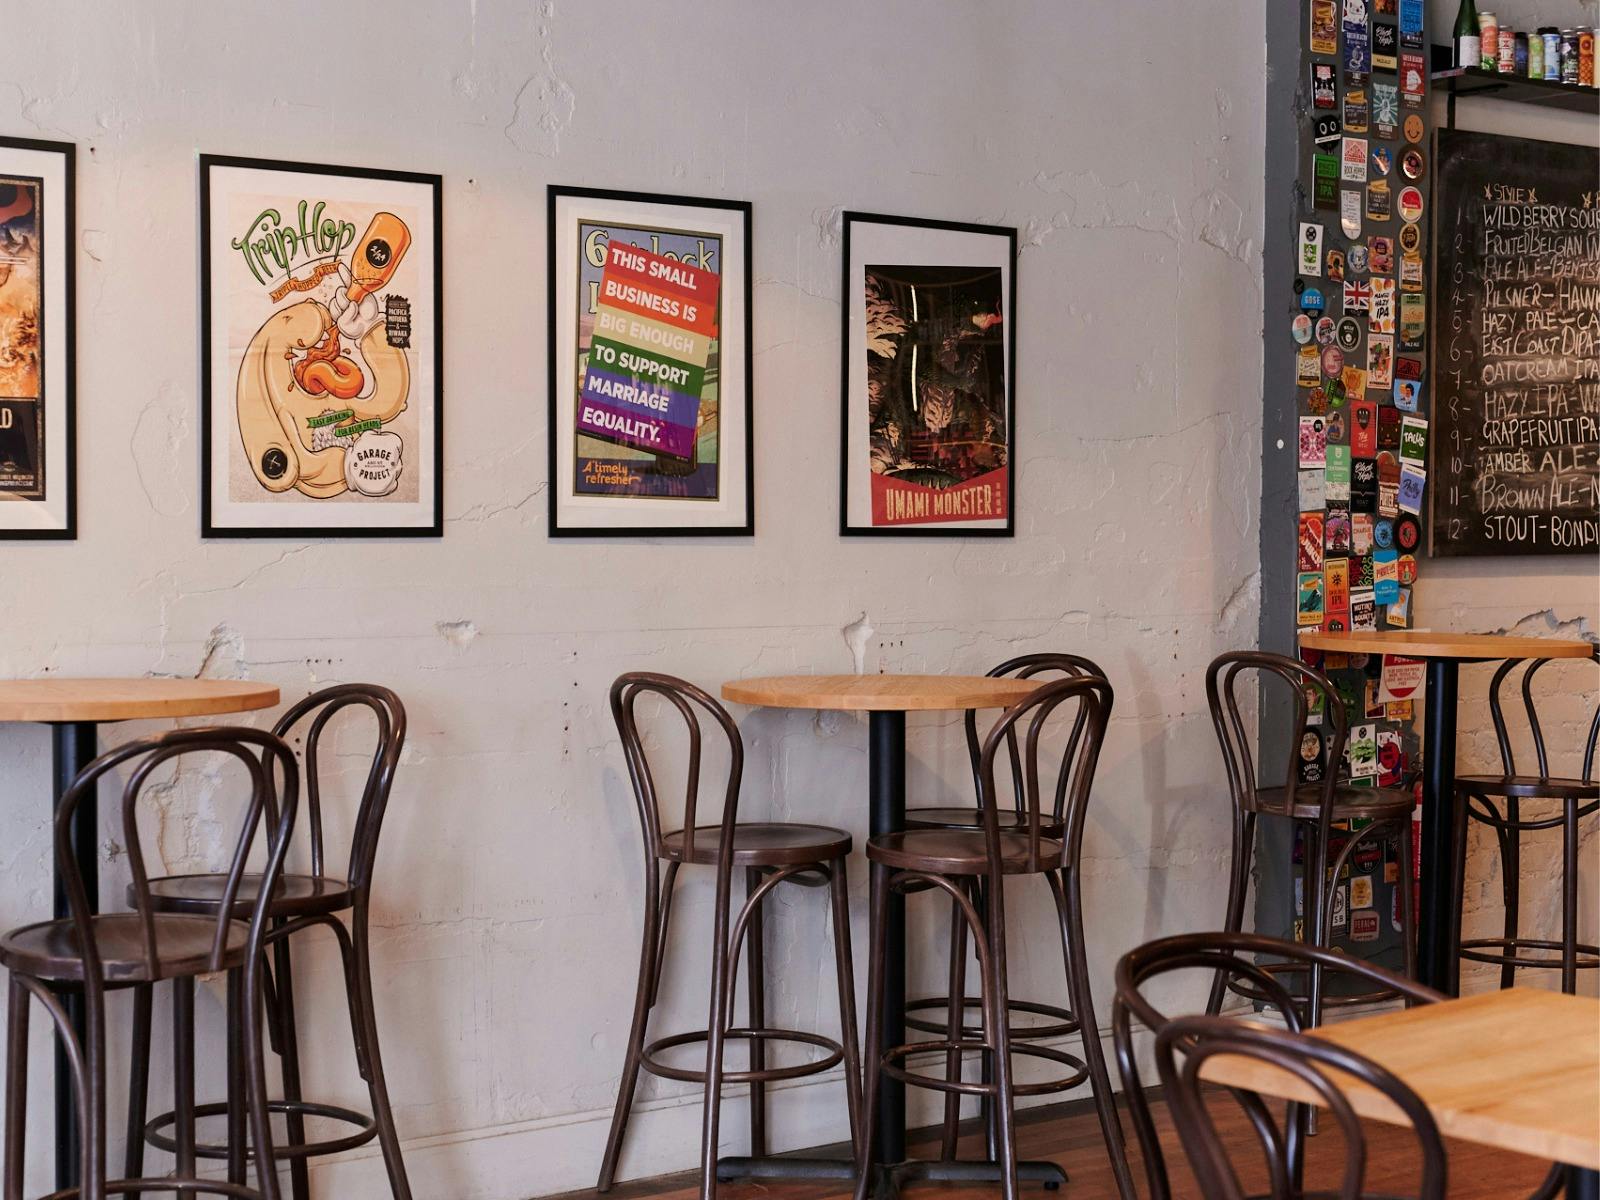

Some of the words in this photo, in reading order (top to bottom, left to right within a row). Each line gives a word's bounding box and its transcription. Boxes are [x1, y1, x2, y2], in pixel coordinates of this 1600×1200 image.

[1493, 183, 1525, 203] STYLE
[1482, 204, 1521, 229] WILD
[1523, 205, 1567, 228] BERRY
[231, 208, 298, 285] Trip
[287, 200, 356, 262] Hop
[1484, 230, 1529, 256] FRUITED
[1526, 226, 1583, 258] BELGIAN
[611, 247, 646, 273] THIS
[648, 260, 697, 291] SMALL
[605, 280, 680, 317] BUSINESS
[682, 303, 698, 323] IS
[1376, 306, 1390, 320] IPA
[600, 312, 626, 333] BIG
[629, 322, 694, 354] ENOUGH
[1482, 308, 1517, 334] HAZY
[1482, 334, 1513, 357] EAST
[1513, 327, 1560, 356] COAST
[594, 344, 616, 364] TO
[618, 352, 690, 386] SUPPORT
[588, 375, 670, 413] MARRIAGE
[1484, 390, 1529, 422] HAZY
[582, 406, 661, 443] EQUALITY.
[1482, 418, 1574, 447] GRAPEFRUIT
[357, 448, 392, 461] GARAGE
[594, 461, 629, 475] timely
[1484, 450, 1533, 474] AMBER
[359, 468, 391, 481] PROJECT
[585, 473, 640, 485] refresher
[886, 488, 930, 521] UMAMI
[934, 484, 993, 516] MONSTER
[1482, 474, 1546, 514] BROWN
